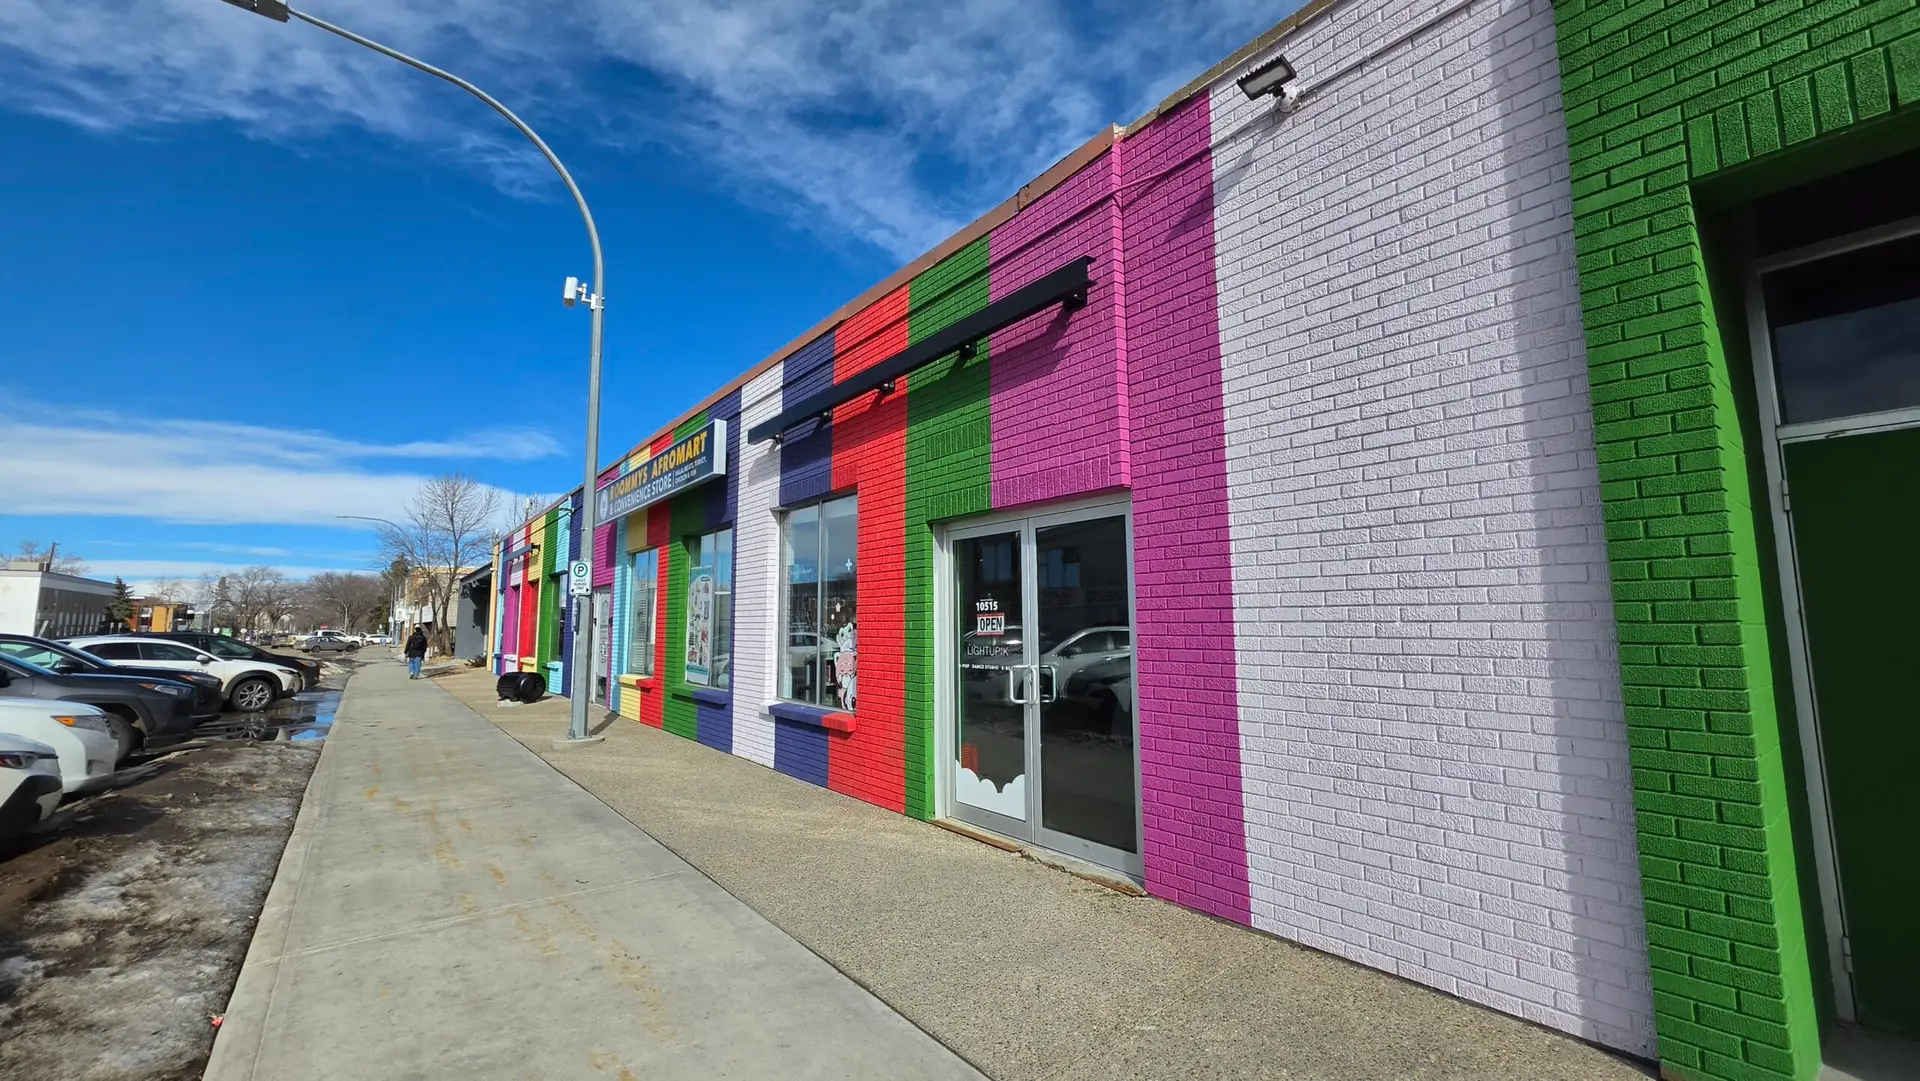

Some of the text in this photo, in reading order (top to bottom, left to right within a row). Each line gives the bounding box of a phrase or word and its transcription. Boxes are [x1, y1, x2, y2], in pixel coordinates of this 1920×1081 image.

[651, 430, 707, 479] AFROMART
[614, 484, 651, 513] CONVENIENCE
[651, 472, 672, 496] STORE
[578, 566, 584, 574] P
[975, 601, 998, 611] 10515
[979, 617, 1002, 631] OPEN
